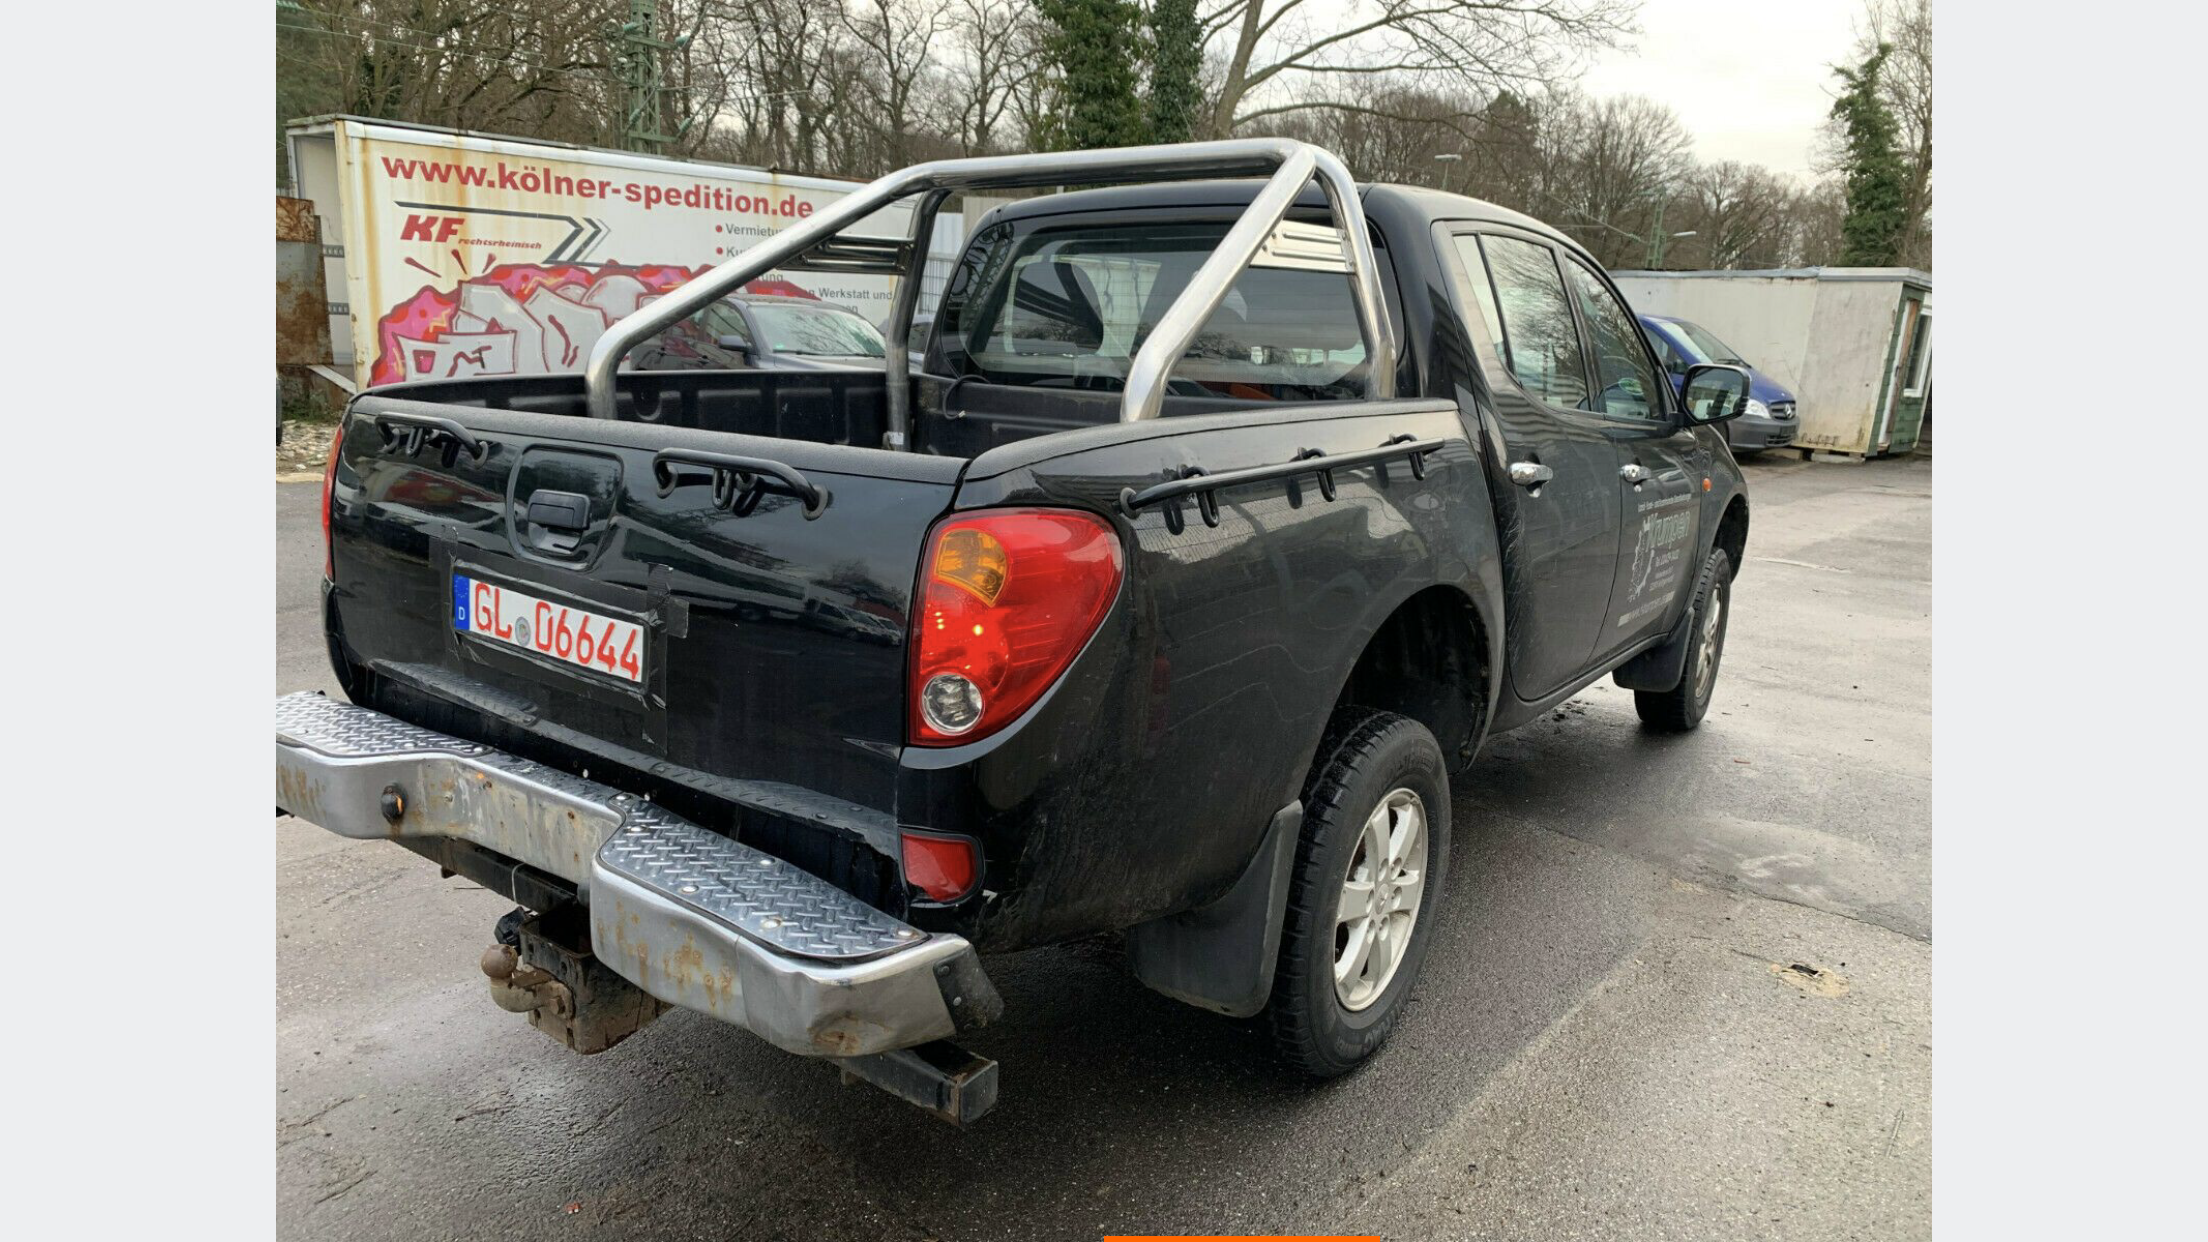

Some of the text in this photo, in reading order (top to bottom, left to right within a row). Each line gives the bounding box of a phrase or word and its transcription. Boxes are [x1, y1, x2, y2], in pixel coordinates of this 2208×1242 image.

[381, 157, 814, 219] www.kölner-spedition.de
[400, 214, 465, 243] KF
[458, 238, 542, 250] rechtsrheinisch
[818, 286, 870, 299] Werkstatt
[872, 290, 893, 300] und
[458, 606, 466, 621] D
[475, 582, 640, 681] GL 06644
